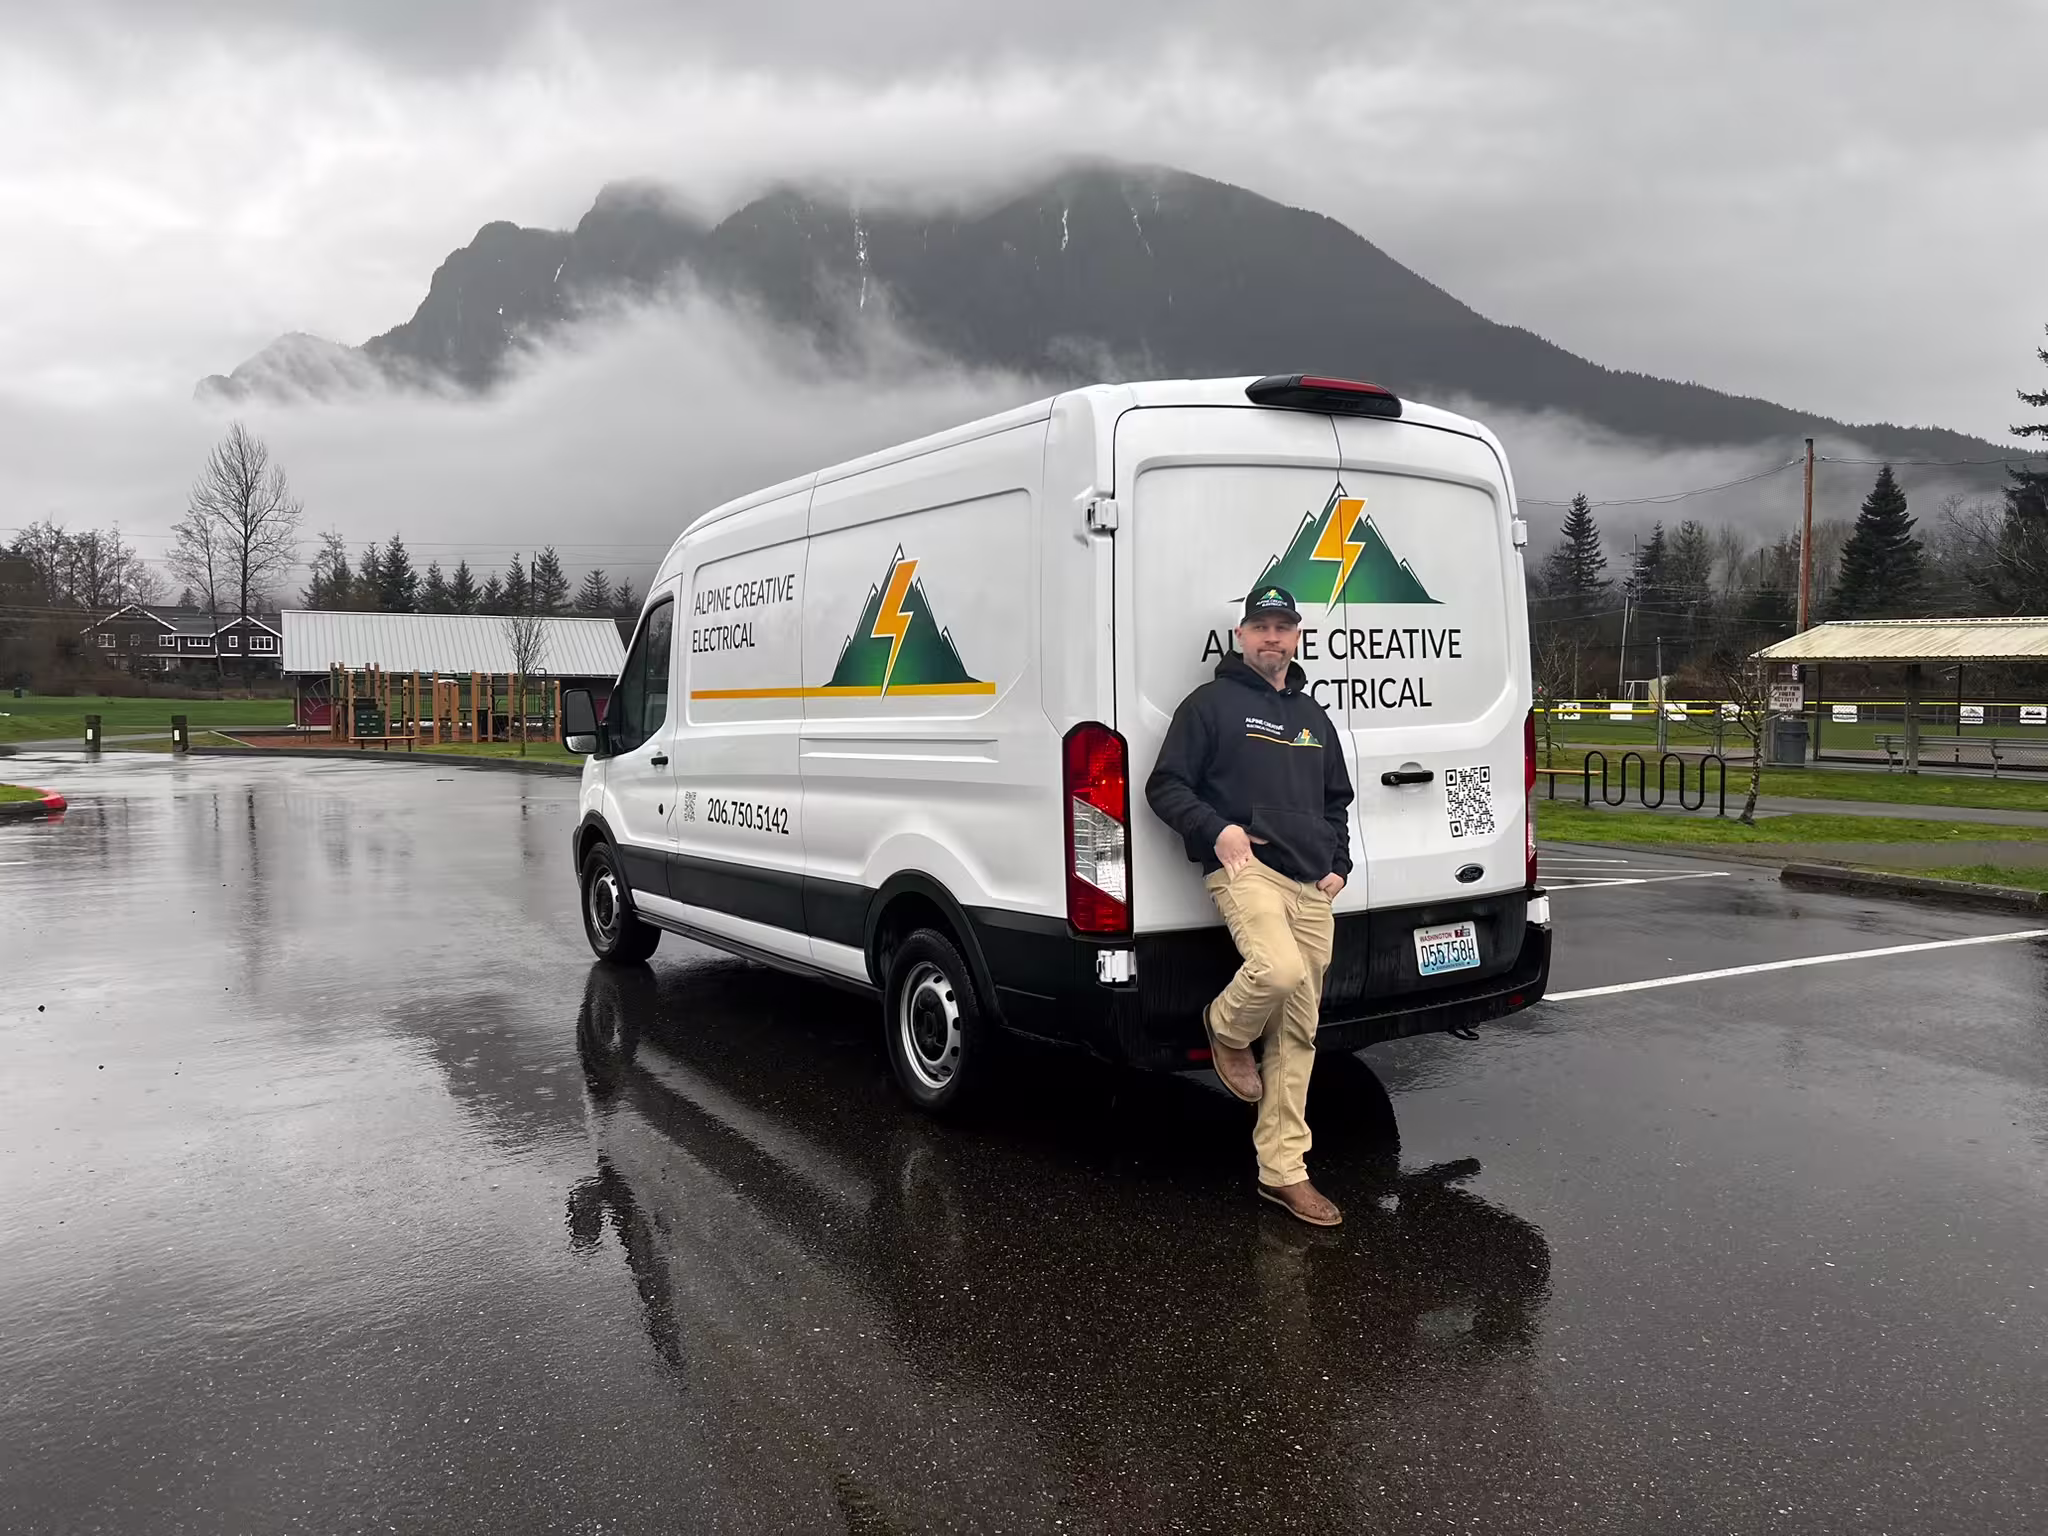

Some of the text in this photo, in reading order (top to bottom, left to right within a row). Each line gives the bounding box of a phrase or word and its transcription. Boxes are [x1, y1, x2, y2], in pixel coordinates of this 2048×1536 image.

[694, 574, 795, 616] ALPINE CREATIVE
[692, 622, 755, 653] ELECTRICAL
[1328, 628, 1462, 660] CREATIVE
[1305, 677, 1433, 710] CTRICAL
[707, 798, 789, 835] 206.750.5142
[1420, 932, 1453, 943] WASHINGTON
[1421, 938, 1476, 967] D55758H
